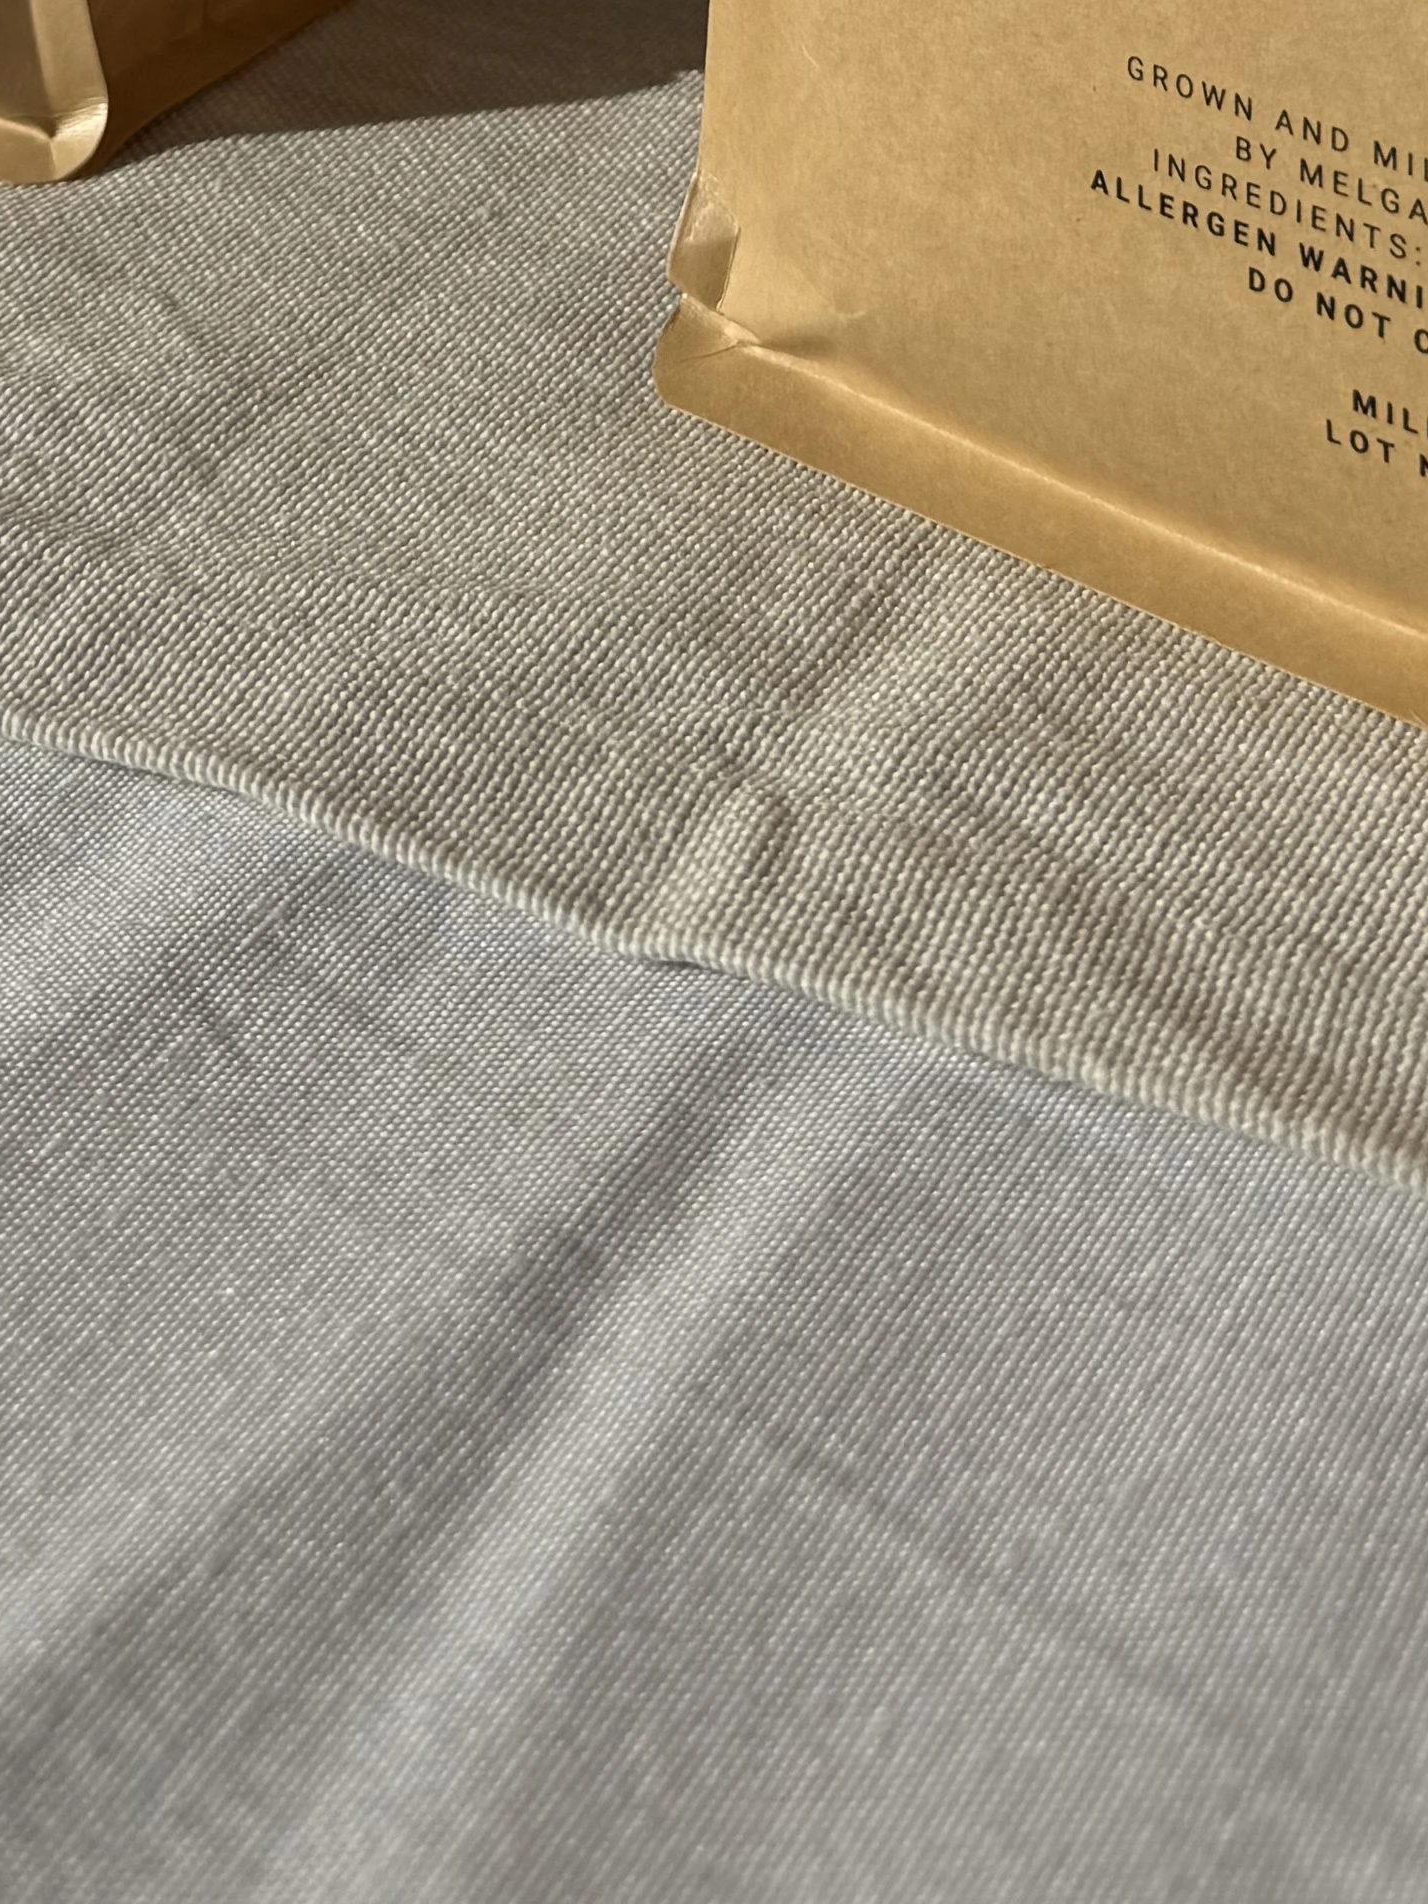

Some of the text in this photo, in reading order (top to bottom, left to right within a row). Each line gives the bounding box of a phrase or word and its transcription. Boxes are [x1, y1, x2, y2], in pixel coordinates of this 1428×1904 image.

[1127, 55, 1253, 122] GROWN
[1274, 109, 1350, 154] AND
[1235, 135, 1277, 171] BY
[1090, 169, 1277, 258] ALLERGEN
[1153, 148, 1421, 267] INGREDIENTS:
[1248, 266, 1294, 307] DO
[1316, 291, 1392, 341] NOT
[1326, 418, 1396, 465] LOT
